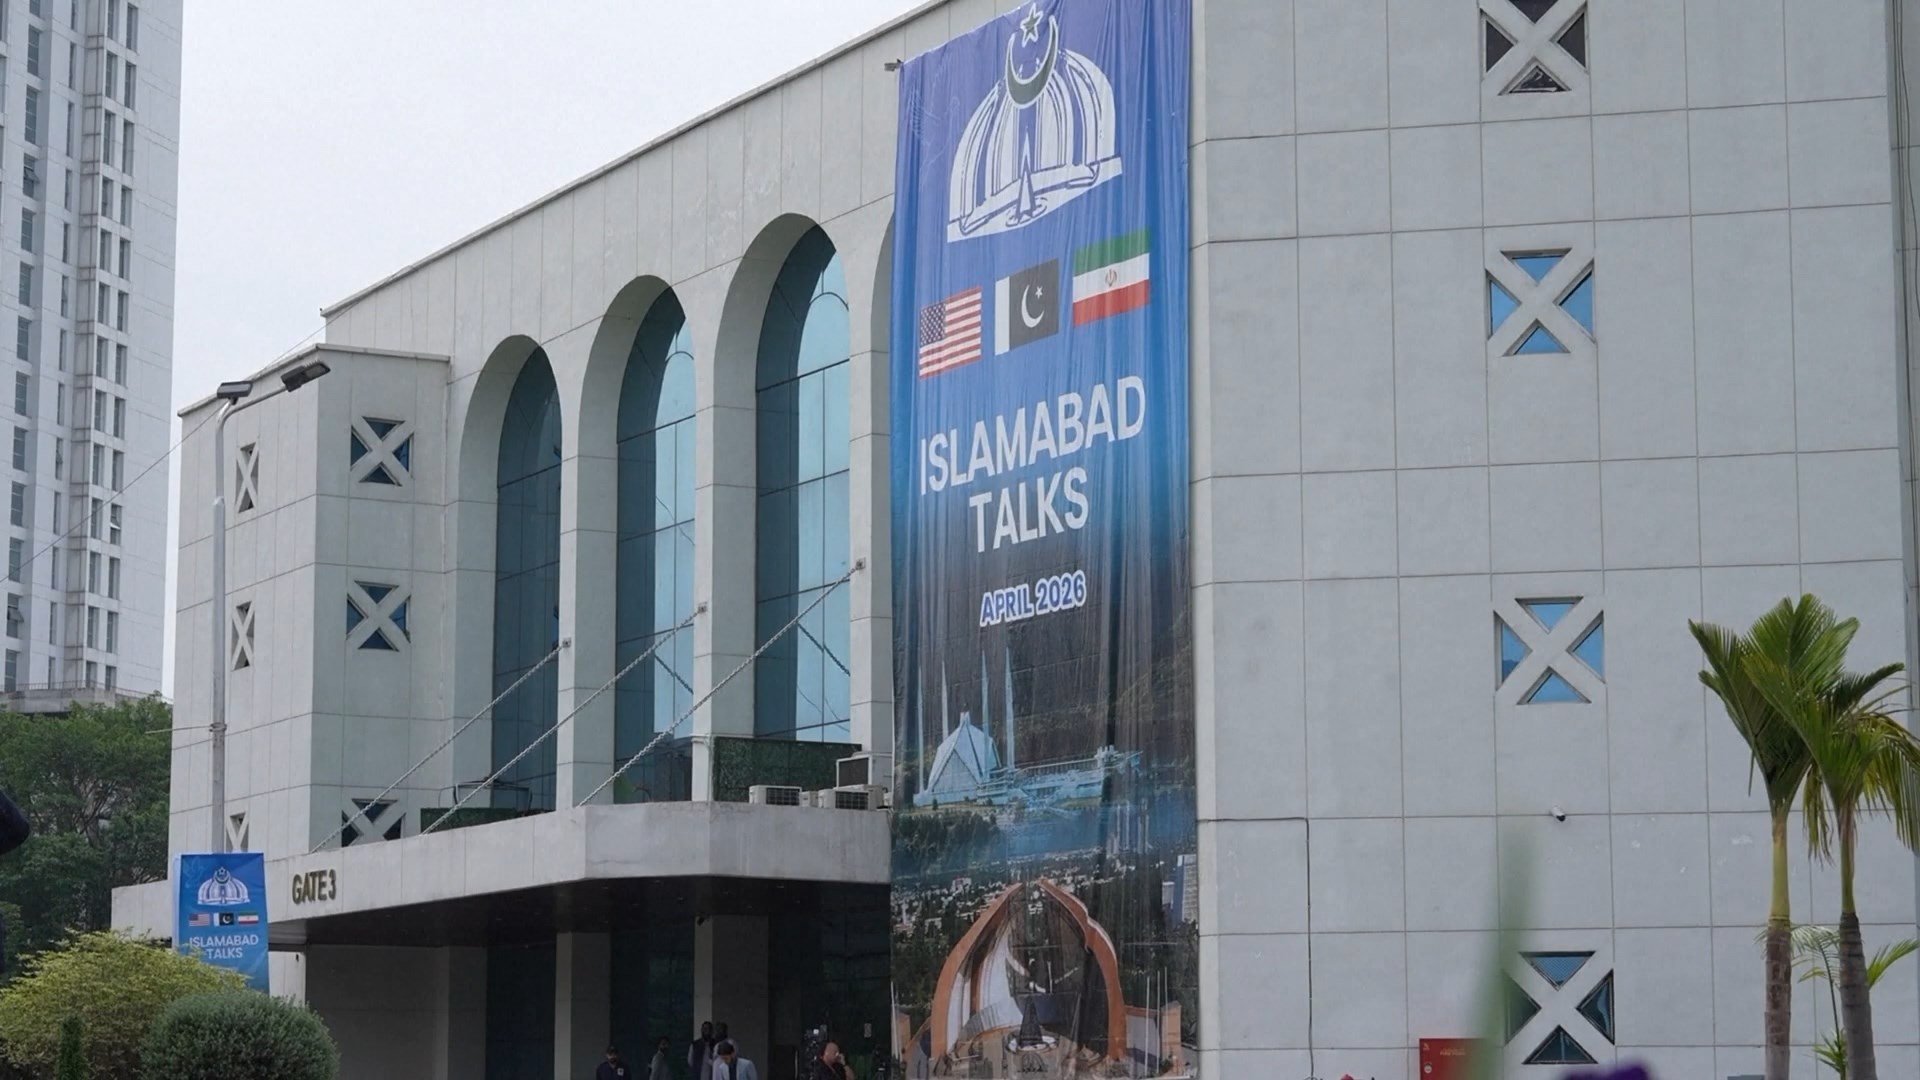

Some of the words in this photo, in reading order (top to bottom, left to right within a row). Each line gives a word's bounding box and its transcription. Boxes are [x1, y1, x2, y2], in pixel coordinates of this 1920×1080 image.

[920, 376, 1145, 495] ISLAMABAD
[969, 467, 1088, 552] TALKS
[980, 585, 1033, 626] APRIL
[1034, 570, 1086, 613] 2026
[292, 870, 327, 904] GATE
[329, 869, 337, 900] 3
[189, 934, 259, 948] ISLAMABAD
[206, 948, 243, 959] TALKS
